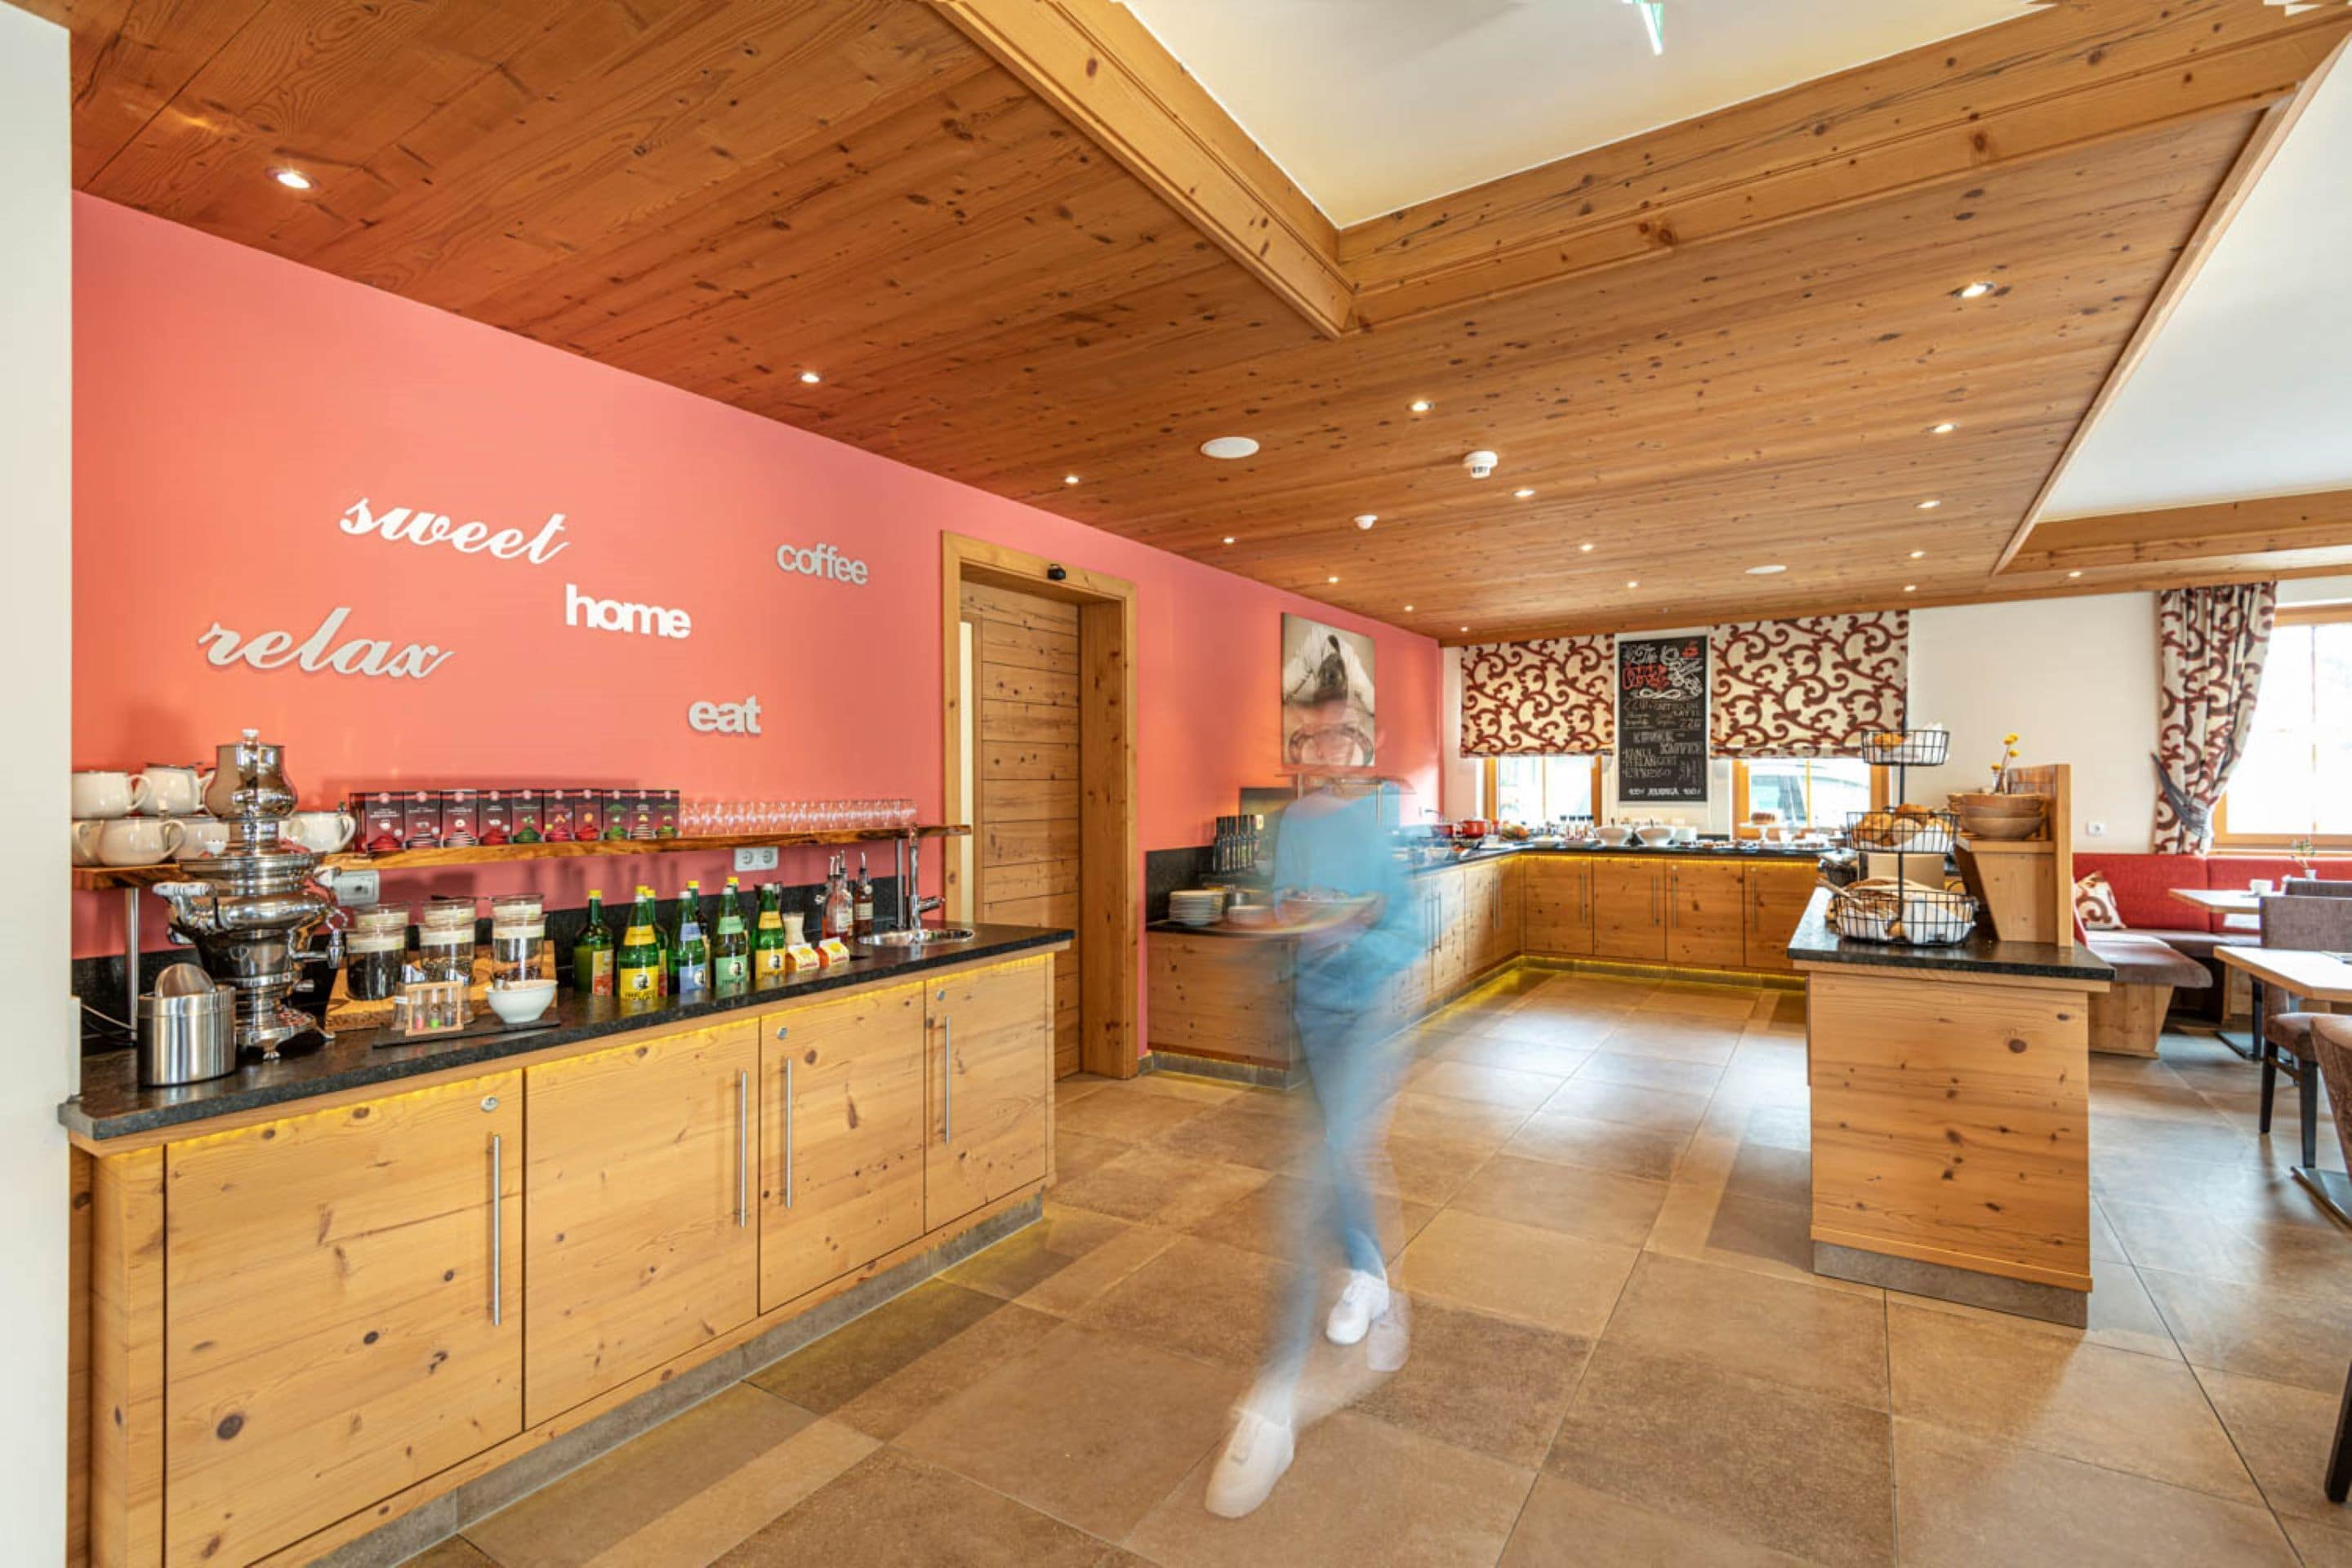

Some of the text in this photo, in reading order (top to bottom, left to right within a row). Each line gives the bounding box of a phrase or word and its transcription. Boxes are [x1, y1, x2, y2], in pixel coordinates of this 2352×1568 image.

[340, 497, 571, 565] sweet
[776, 542, 868, 586] coffee
[565, 583, 692, 639] home
[198, 607, 455, 679] relax
[688, 694, 763, 734] eat
